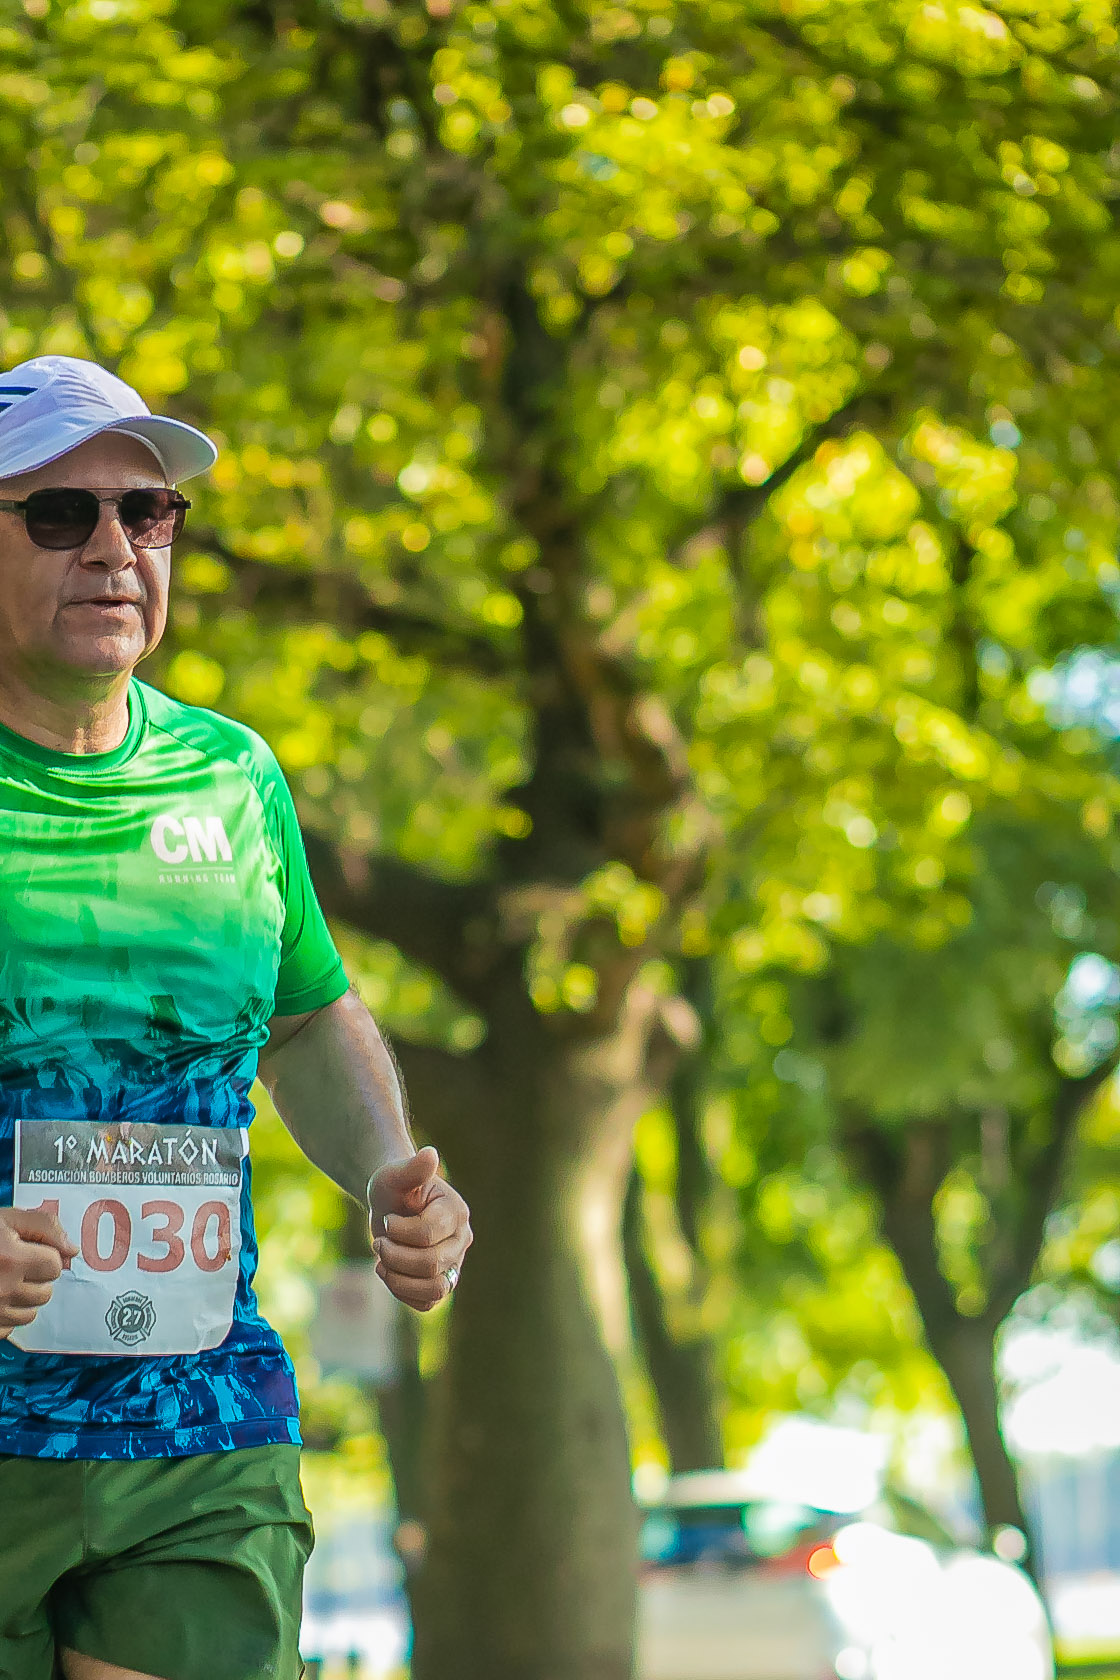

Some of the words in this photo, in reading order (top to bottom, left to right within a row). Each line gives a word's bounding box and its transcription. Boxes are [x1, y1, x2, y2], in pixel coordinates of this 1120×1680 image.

[150, 815, 233, 864] CM
[86, 1128, 218, 1166] MARATÓN
[122, 1307, 142, 1327] 27
